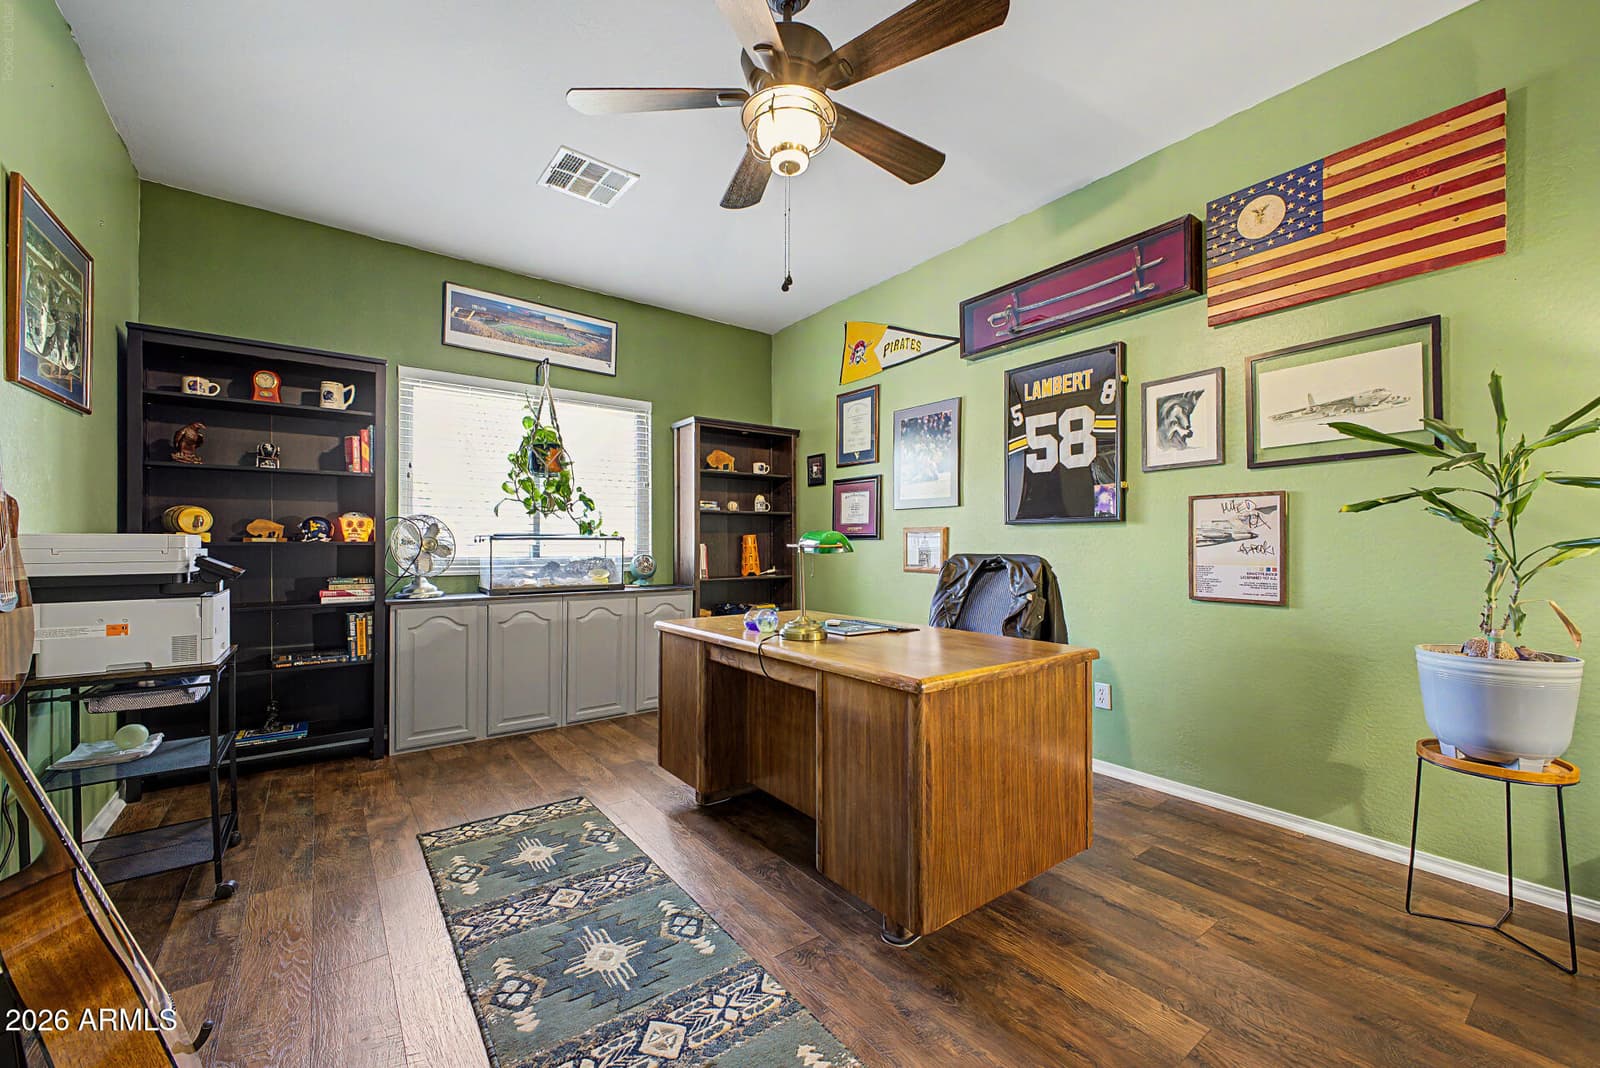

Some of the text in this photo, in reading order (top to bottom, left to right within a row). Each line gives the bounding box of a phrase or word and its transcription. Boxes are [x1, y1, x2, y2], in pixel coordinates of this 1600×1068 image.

[882, 337, 922, 358] PIRATES
[1024, 368, 1094, 402] LAMBERT
[1100, 379, 1116, 405] 8
[1010, 403, 1024, 427] 5
[1025, 405, 1097, 473] 58
